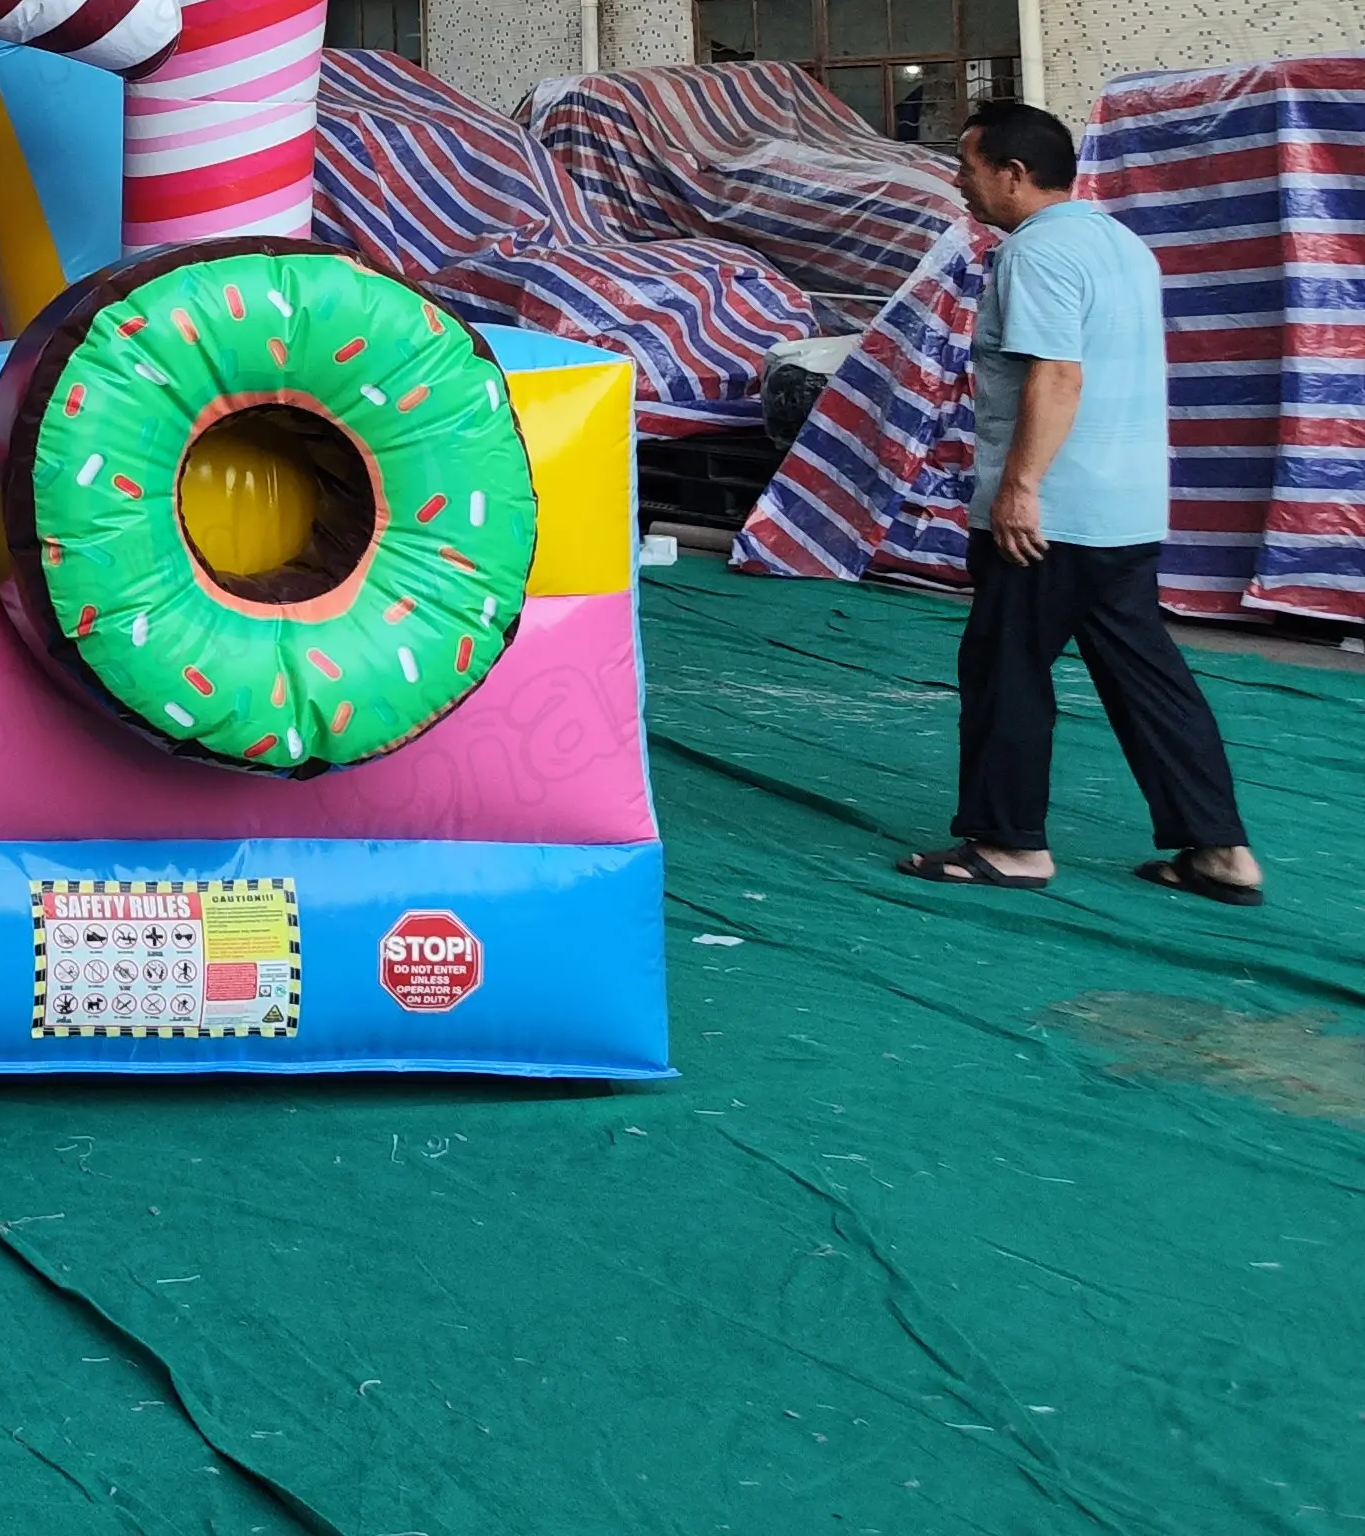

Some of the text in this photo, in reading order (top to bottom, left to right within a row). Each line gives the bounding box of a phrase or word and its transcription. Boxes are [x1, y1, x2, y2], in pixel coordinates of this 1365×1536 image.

[55, 895, 191, 919] SAFETY RULES
[387, 935, 473, 962] STOP!
[394, 965, 467, 975] DO NOT ENTER
[410, 975, 450, 984] UNLESS
[396, 985, 463, 995] OPERATOR IS
[406, 995, 451, 1003] ON DUTY
